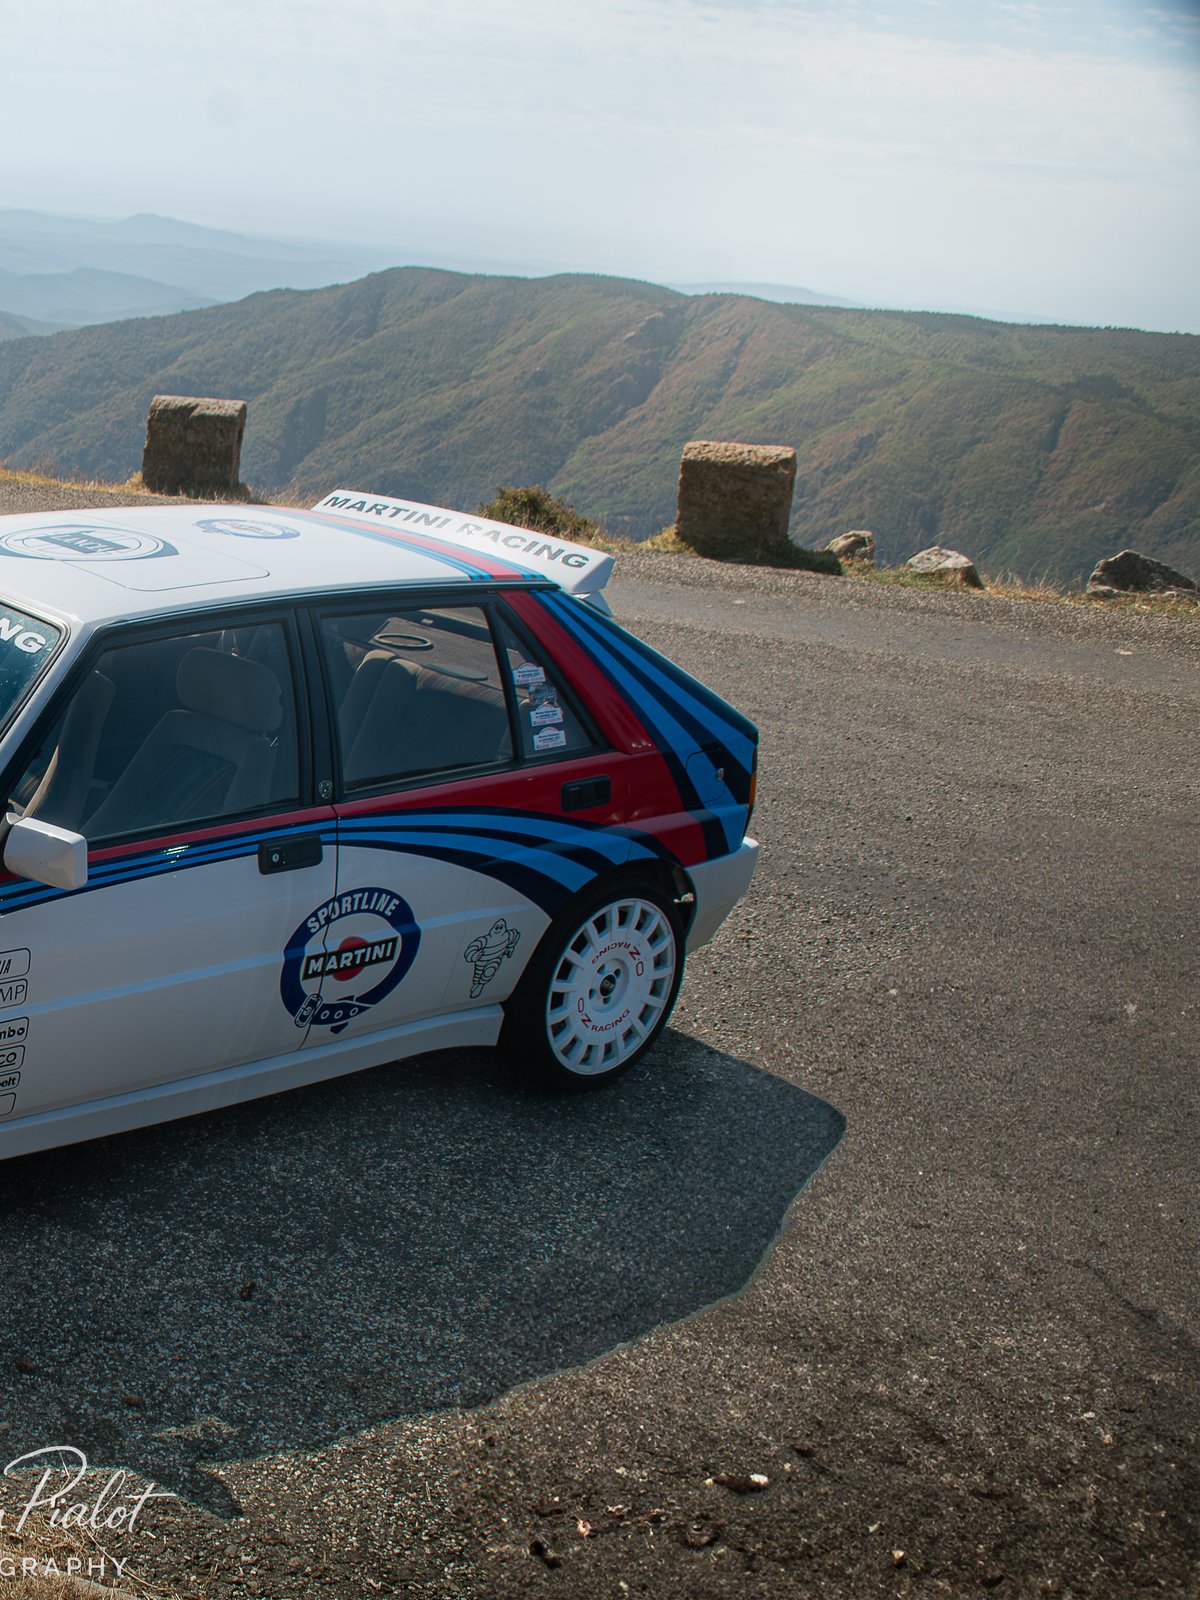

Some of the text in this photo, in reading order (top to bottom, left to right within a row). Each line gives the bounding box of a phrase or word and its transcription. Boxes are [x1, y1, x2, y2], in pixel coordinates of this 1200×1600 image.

[323, 496, 590, 569] MARTINI RACING
[307, 891, 400, 934] SPORTLINE
[308, 941, 393, 975] MARTINI
[592, 941, 631, 964] RACING
[591, 1008, 630, 1032] RACING
